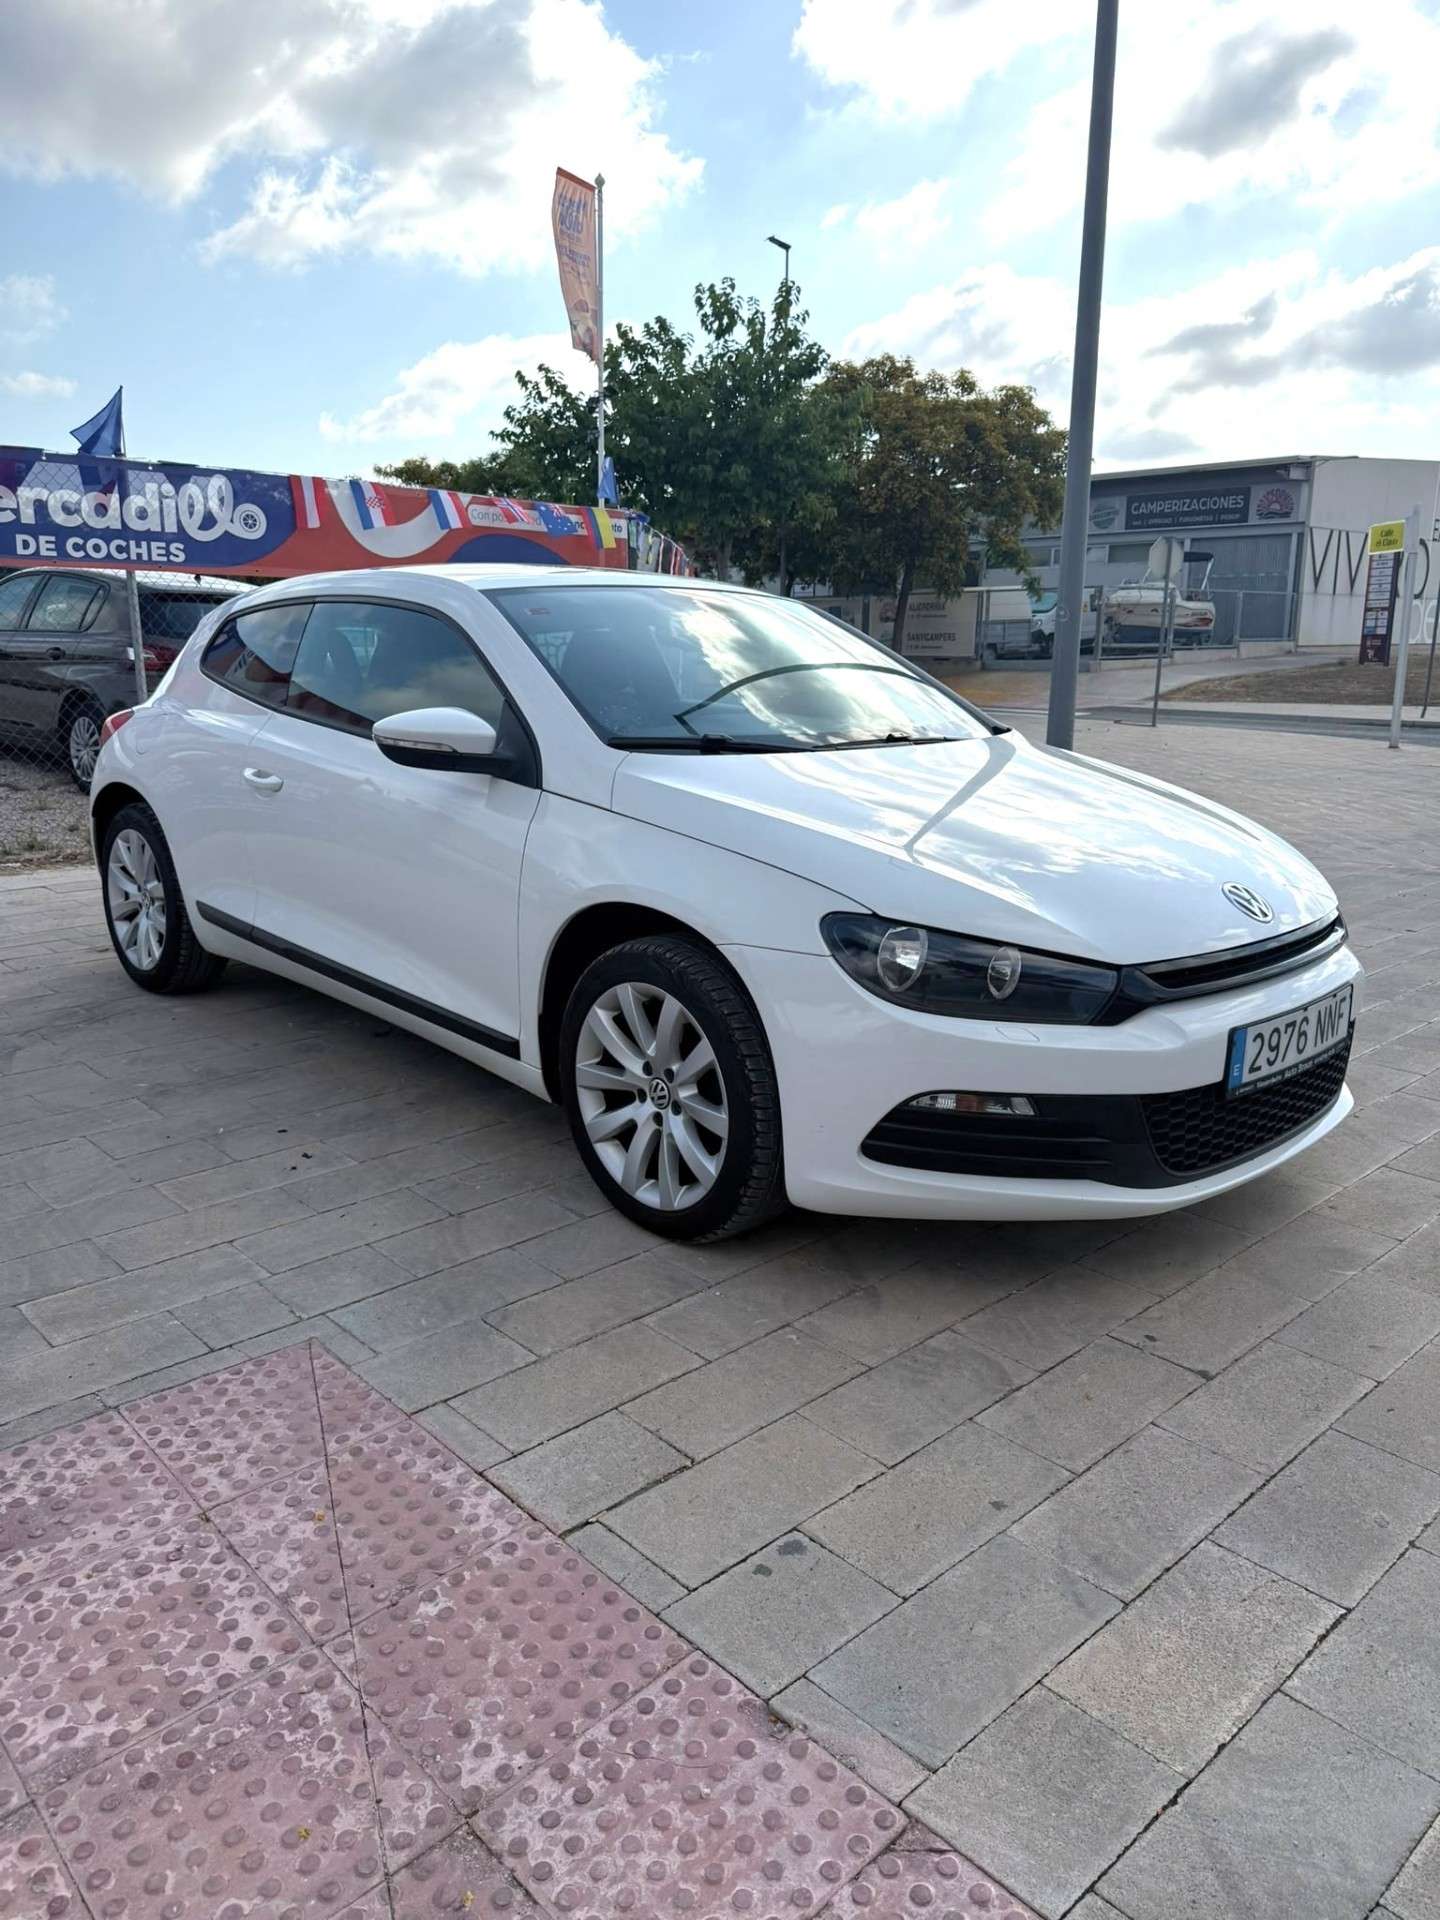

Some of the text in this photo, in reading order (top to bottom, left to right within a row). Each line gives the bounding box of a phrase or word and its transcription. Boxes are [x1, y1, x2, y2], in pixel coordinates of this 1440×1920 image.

[1131, 495, 1244, 515] CAMPERIZACIONES
[16, 534, 186, 563] DE COCHES
[1248, 997, 1346, 1074] 2976 NNF
